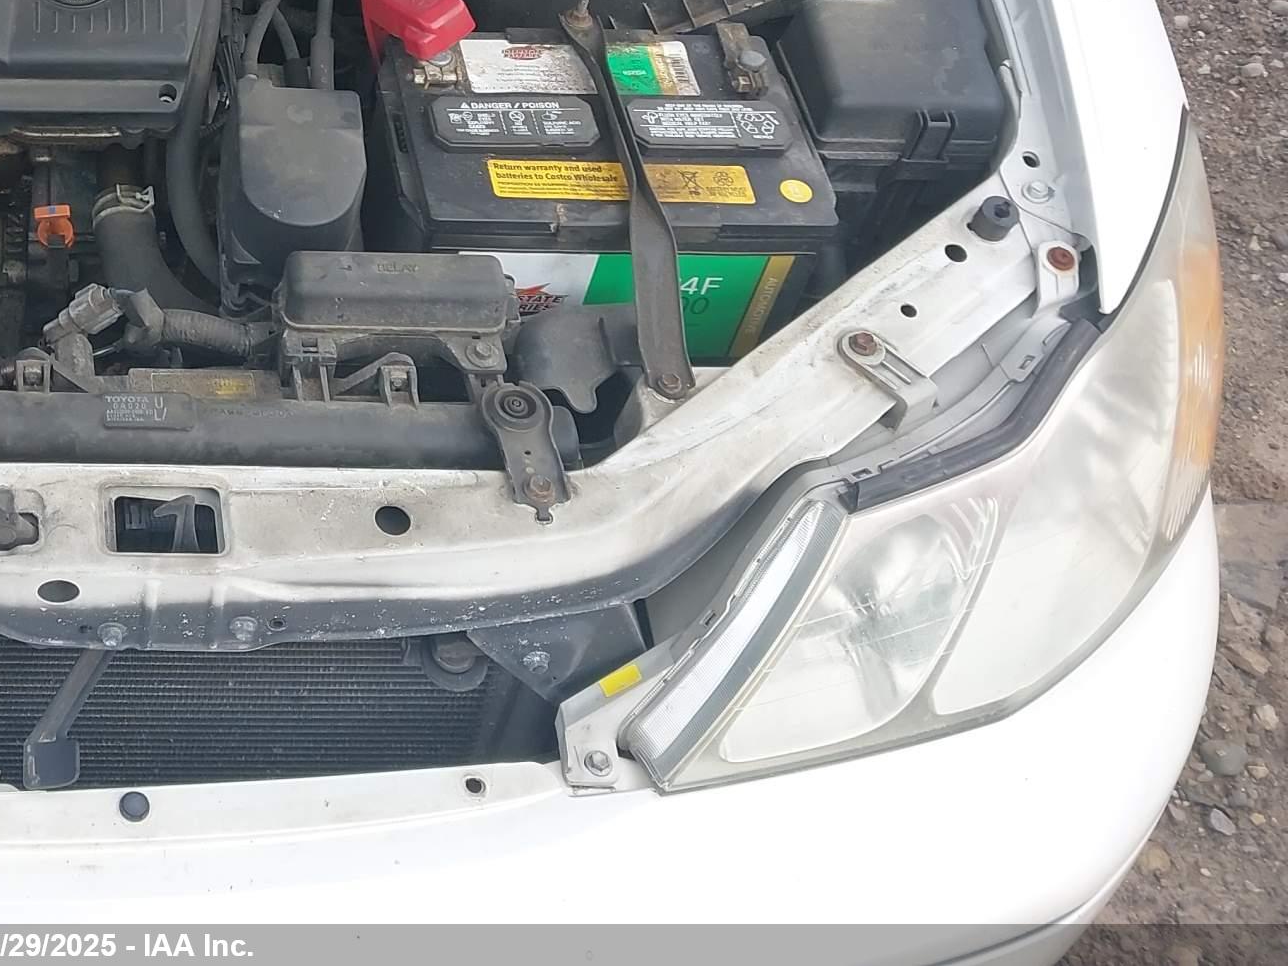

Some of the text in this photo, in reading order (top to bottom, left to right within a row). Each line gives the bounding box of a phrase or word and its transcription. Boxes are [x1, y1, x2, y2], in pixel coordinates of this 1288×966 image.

[493, 162, 602, 173] Return warranty and used
[496, 171, 533, 180] batteries
[546, 172, 572, 180] Costco
[574, 173, 618, 182] Wholesale
[679, 276, 724, 295] 4F
[518, 295, 564, 304] STATE
[519, 304, 553, 312] RIES
[105, 395, 149, 403] TOYOTA
